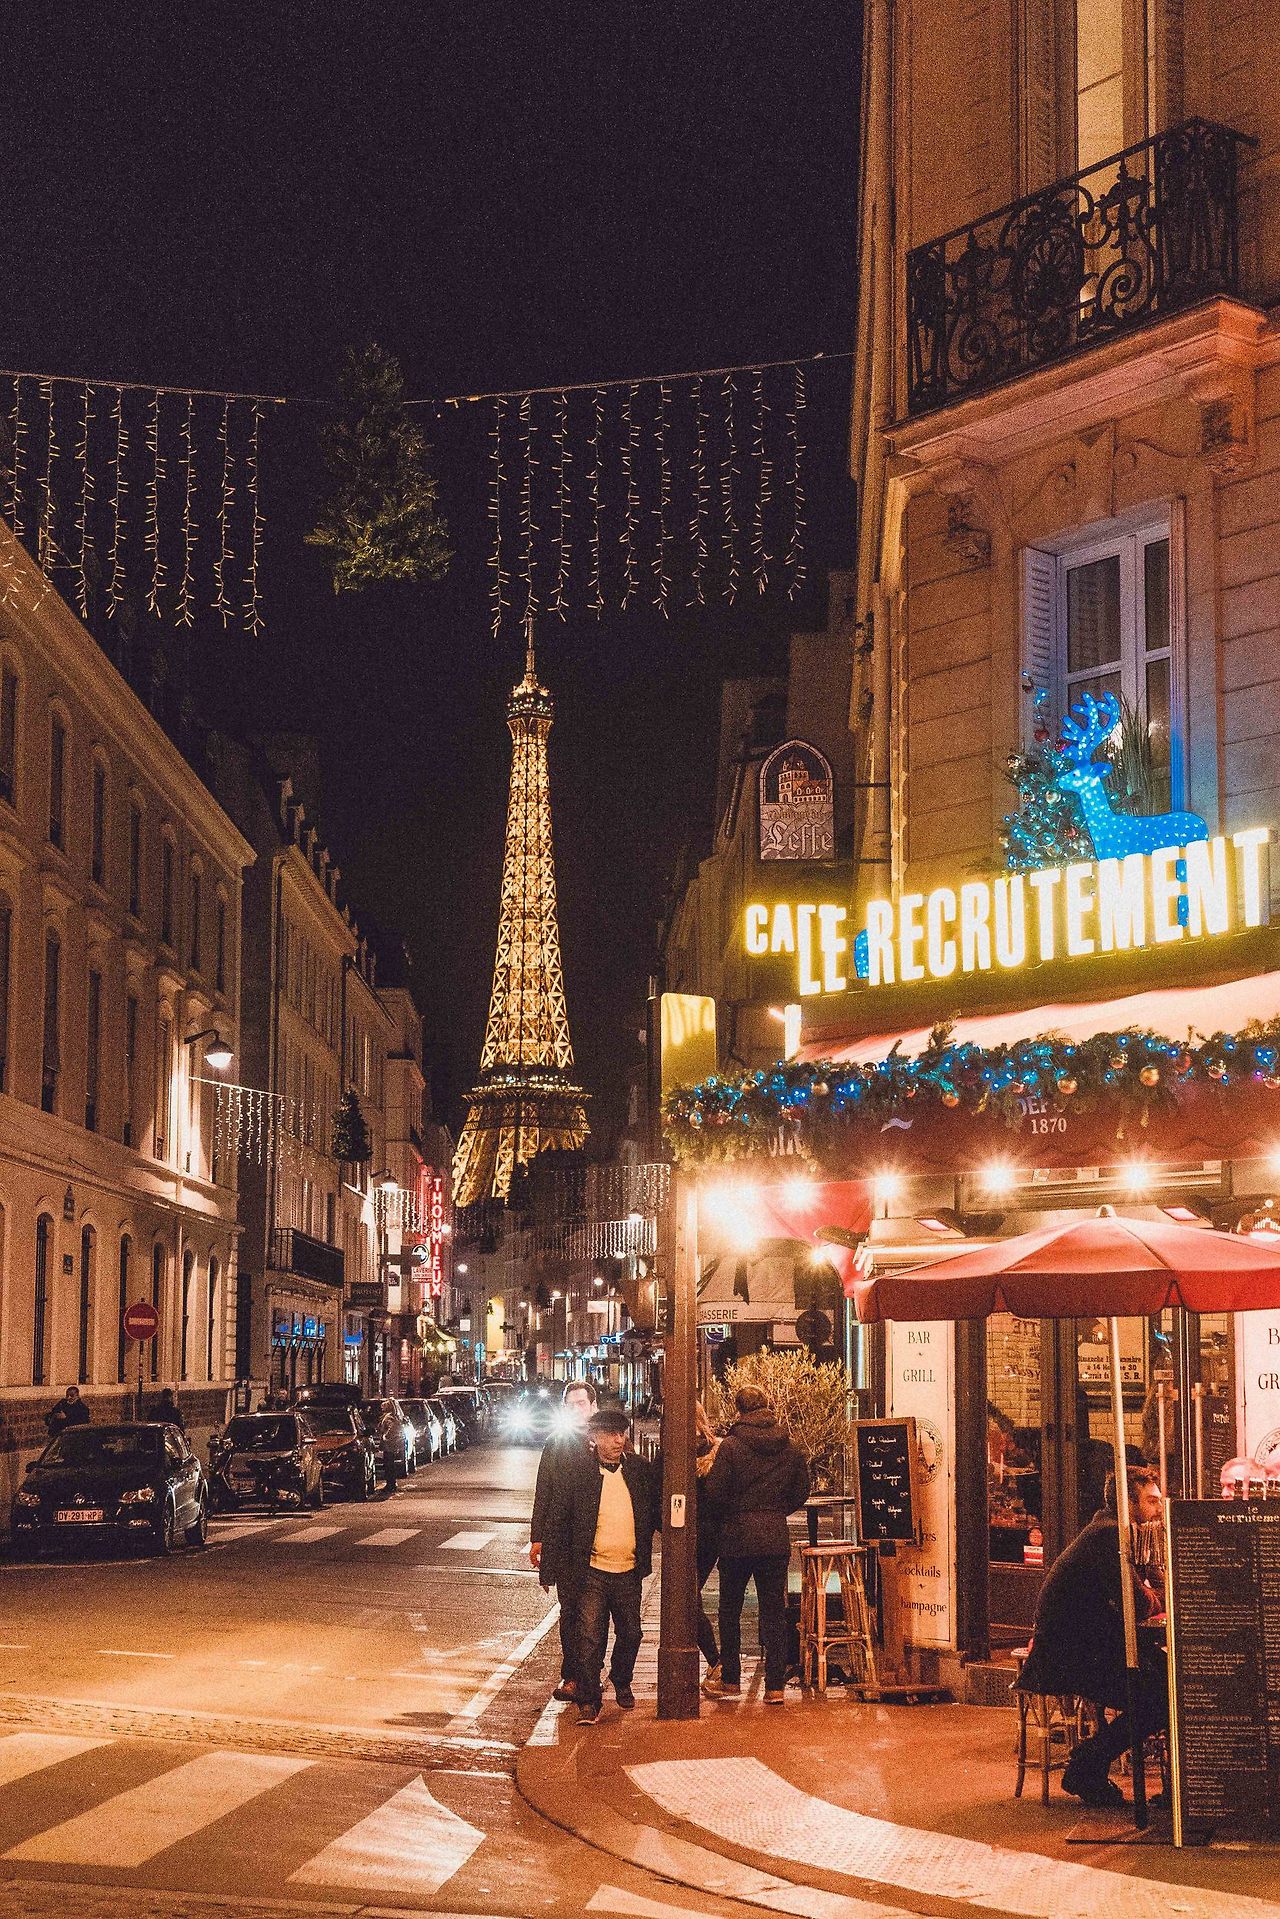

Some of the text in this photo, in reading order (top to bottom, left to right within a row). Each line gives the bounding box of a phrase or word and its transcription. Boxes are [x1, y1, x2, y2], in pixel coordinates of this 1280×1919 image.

[764, 821, 833, 857] Leffe
[798, 826, 1269, 996] LE RECRUTEMENT
[1031, 1118, 1067, 1135] 1870
[431, 1178, 442, 1296] THOUMIEUX
[908, 1331, 930, 1344] BAR
[903, 1369, 936, 1382] GRILL
[1258, 1373, 1280, 1390] GR
[904, 1564, 941, 1578] ocktails
[900, 1597, 947, 1618] hampagne
